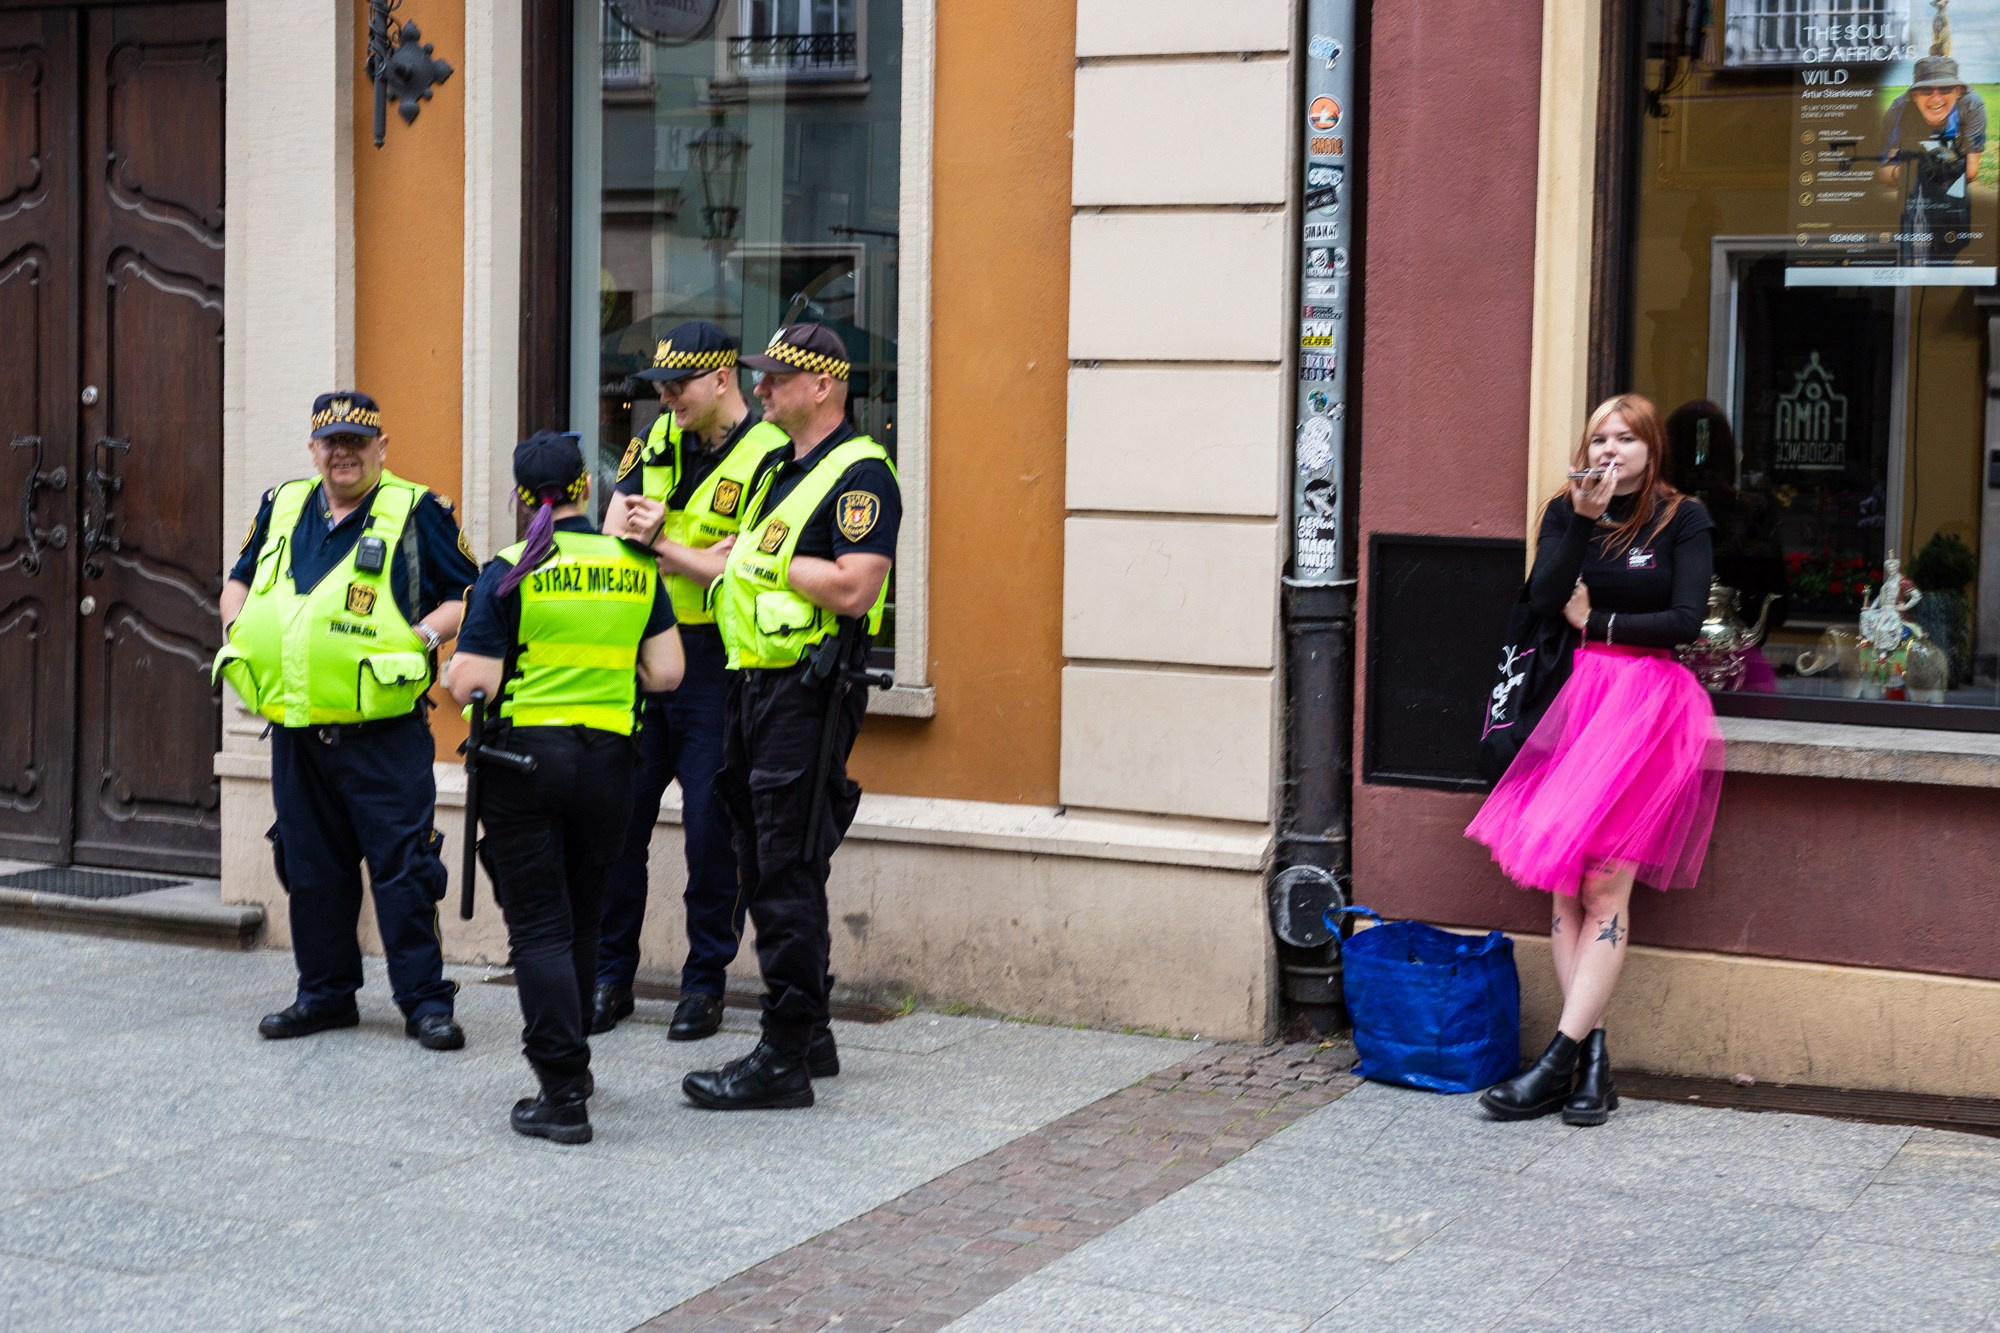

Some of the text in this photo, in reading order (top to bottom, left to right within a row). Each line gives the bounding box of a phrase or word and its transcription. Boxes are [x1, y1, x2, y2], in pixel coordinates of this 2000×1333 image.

[1803, 24, 1896, 41] THE SOUL
[1802, 44, 1919, 63] OF AFRICA'S
[1802, 69, 1849, 85] WILD
[1801, 89, 1822, 98] Artur
[1303, 338, 1331, 346] CLUB
[533, 562, 647, 596] STRAŻ MIEJSKA
